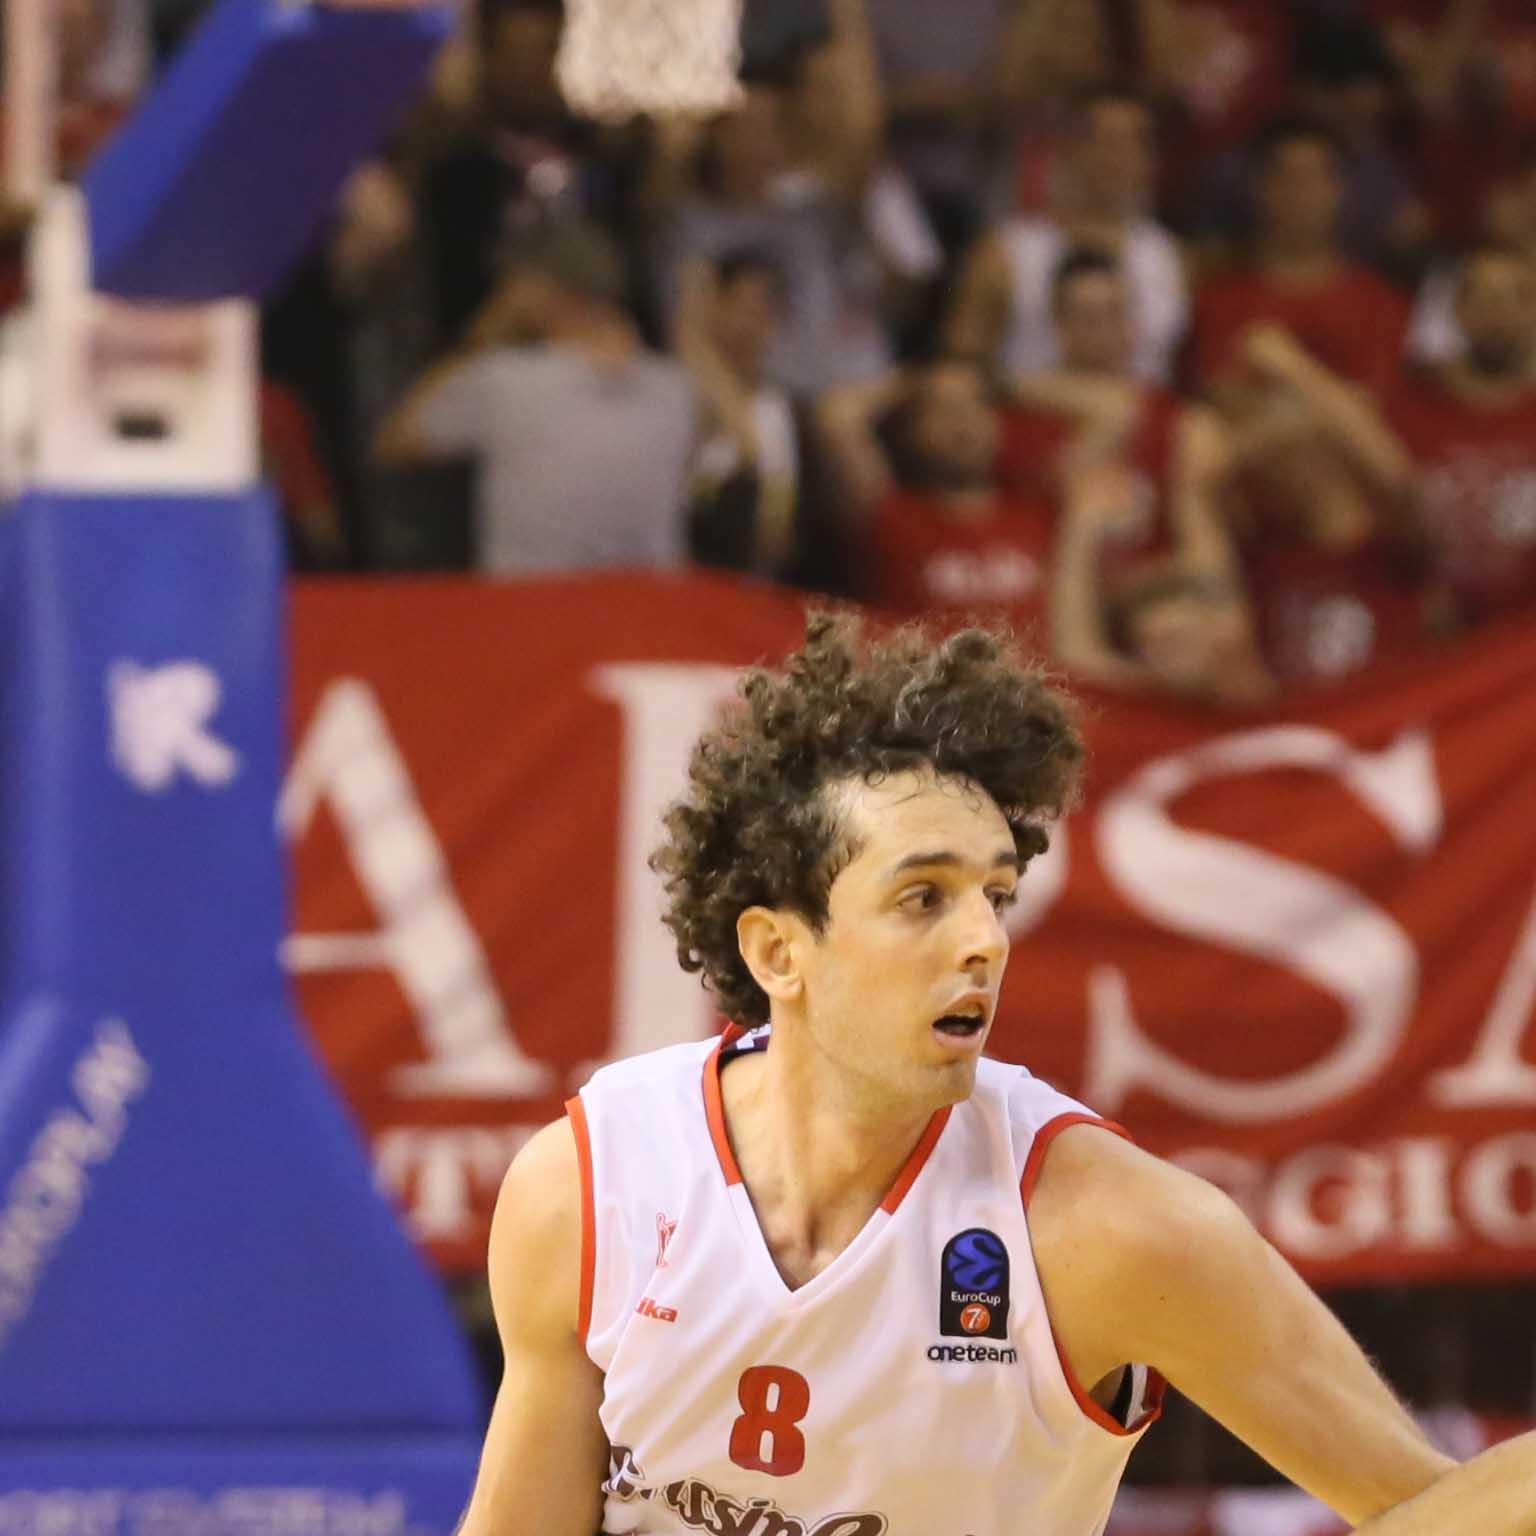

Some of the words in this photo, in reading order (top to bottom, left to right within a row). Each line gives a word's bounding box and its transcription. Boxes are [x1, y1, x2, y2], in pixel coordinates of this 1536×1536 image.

[636, 1297, 679, 1323] ika
[951, 1291, 1001, 1307] EuroCup
[927, 1343, 1018, 1365] oneteam
[728, 1365, 811, 1477] 8
